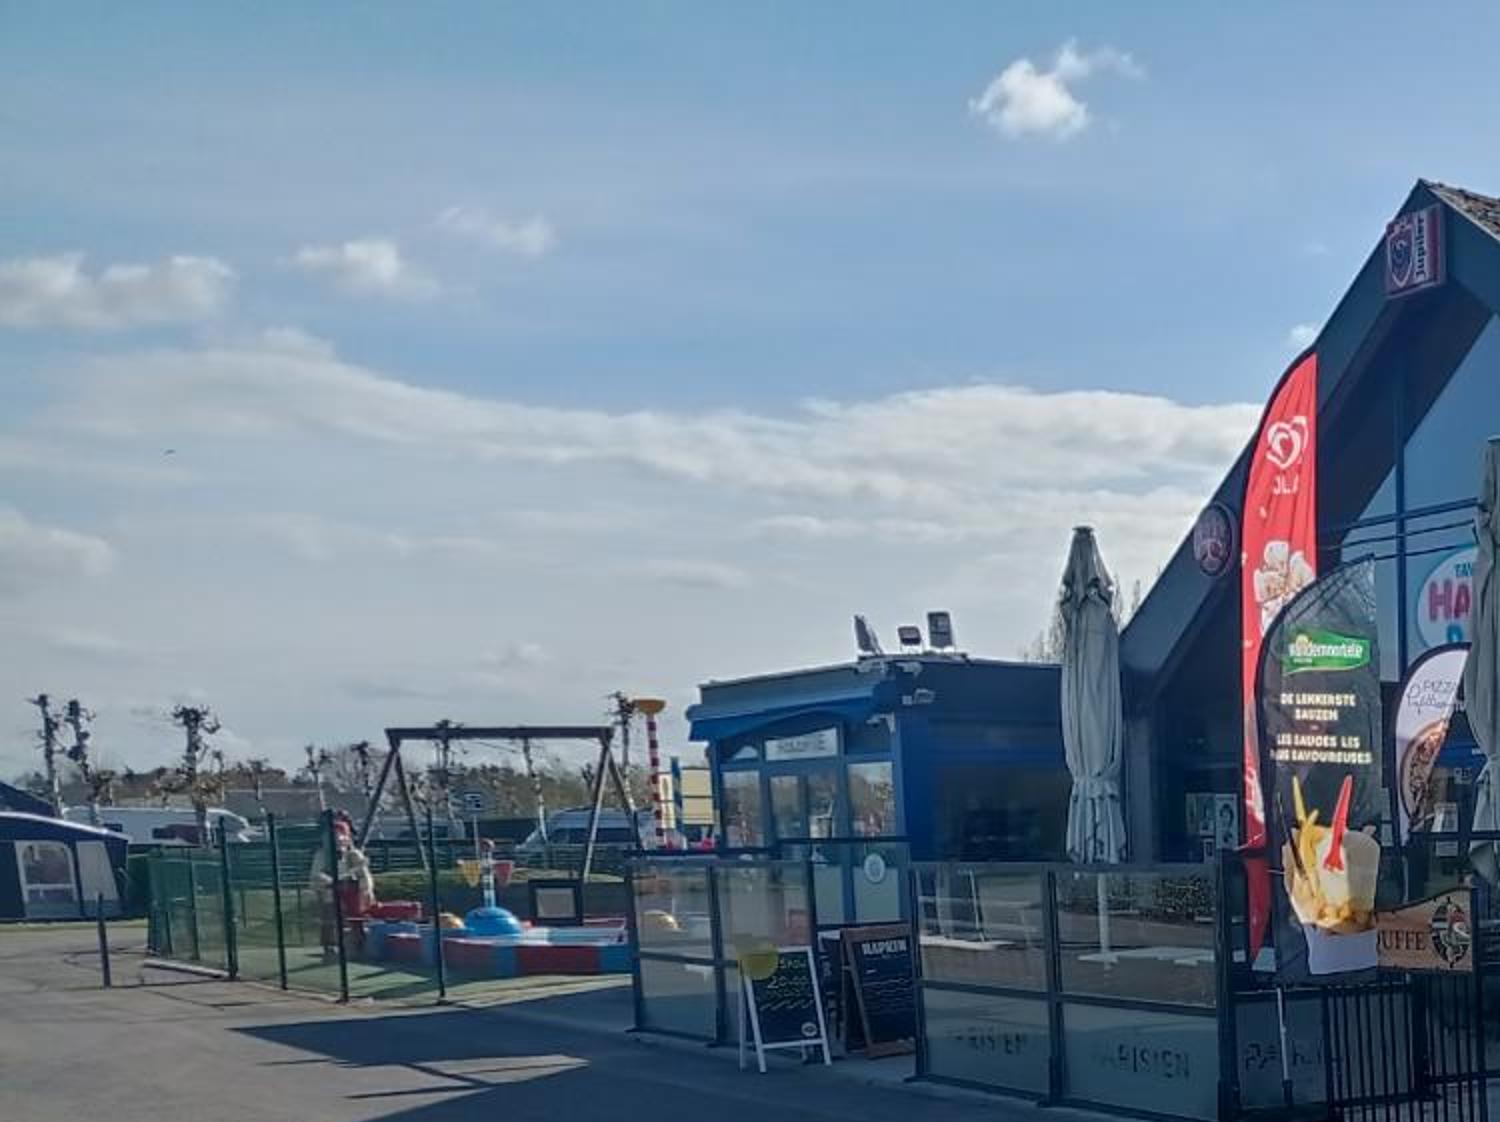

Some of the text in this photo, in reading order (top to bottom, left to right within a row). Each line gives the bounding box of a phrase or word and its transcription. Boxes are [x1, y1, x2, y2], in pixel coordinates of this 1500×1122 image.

[1281, 693, 1356, 707] DE LEKKERSTE
[1295, 708, 1338, 721] SAUZEN
[1277, 734, 1360, 749] LES SAUCES LES
[1377, 928, 1426, 951] UFFE
